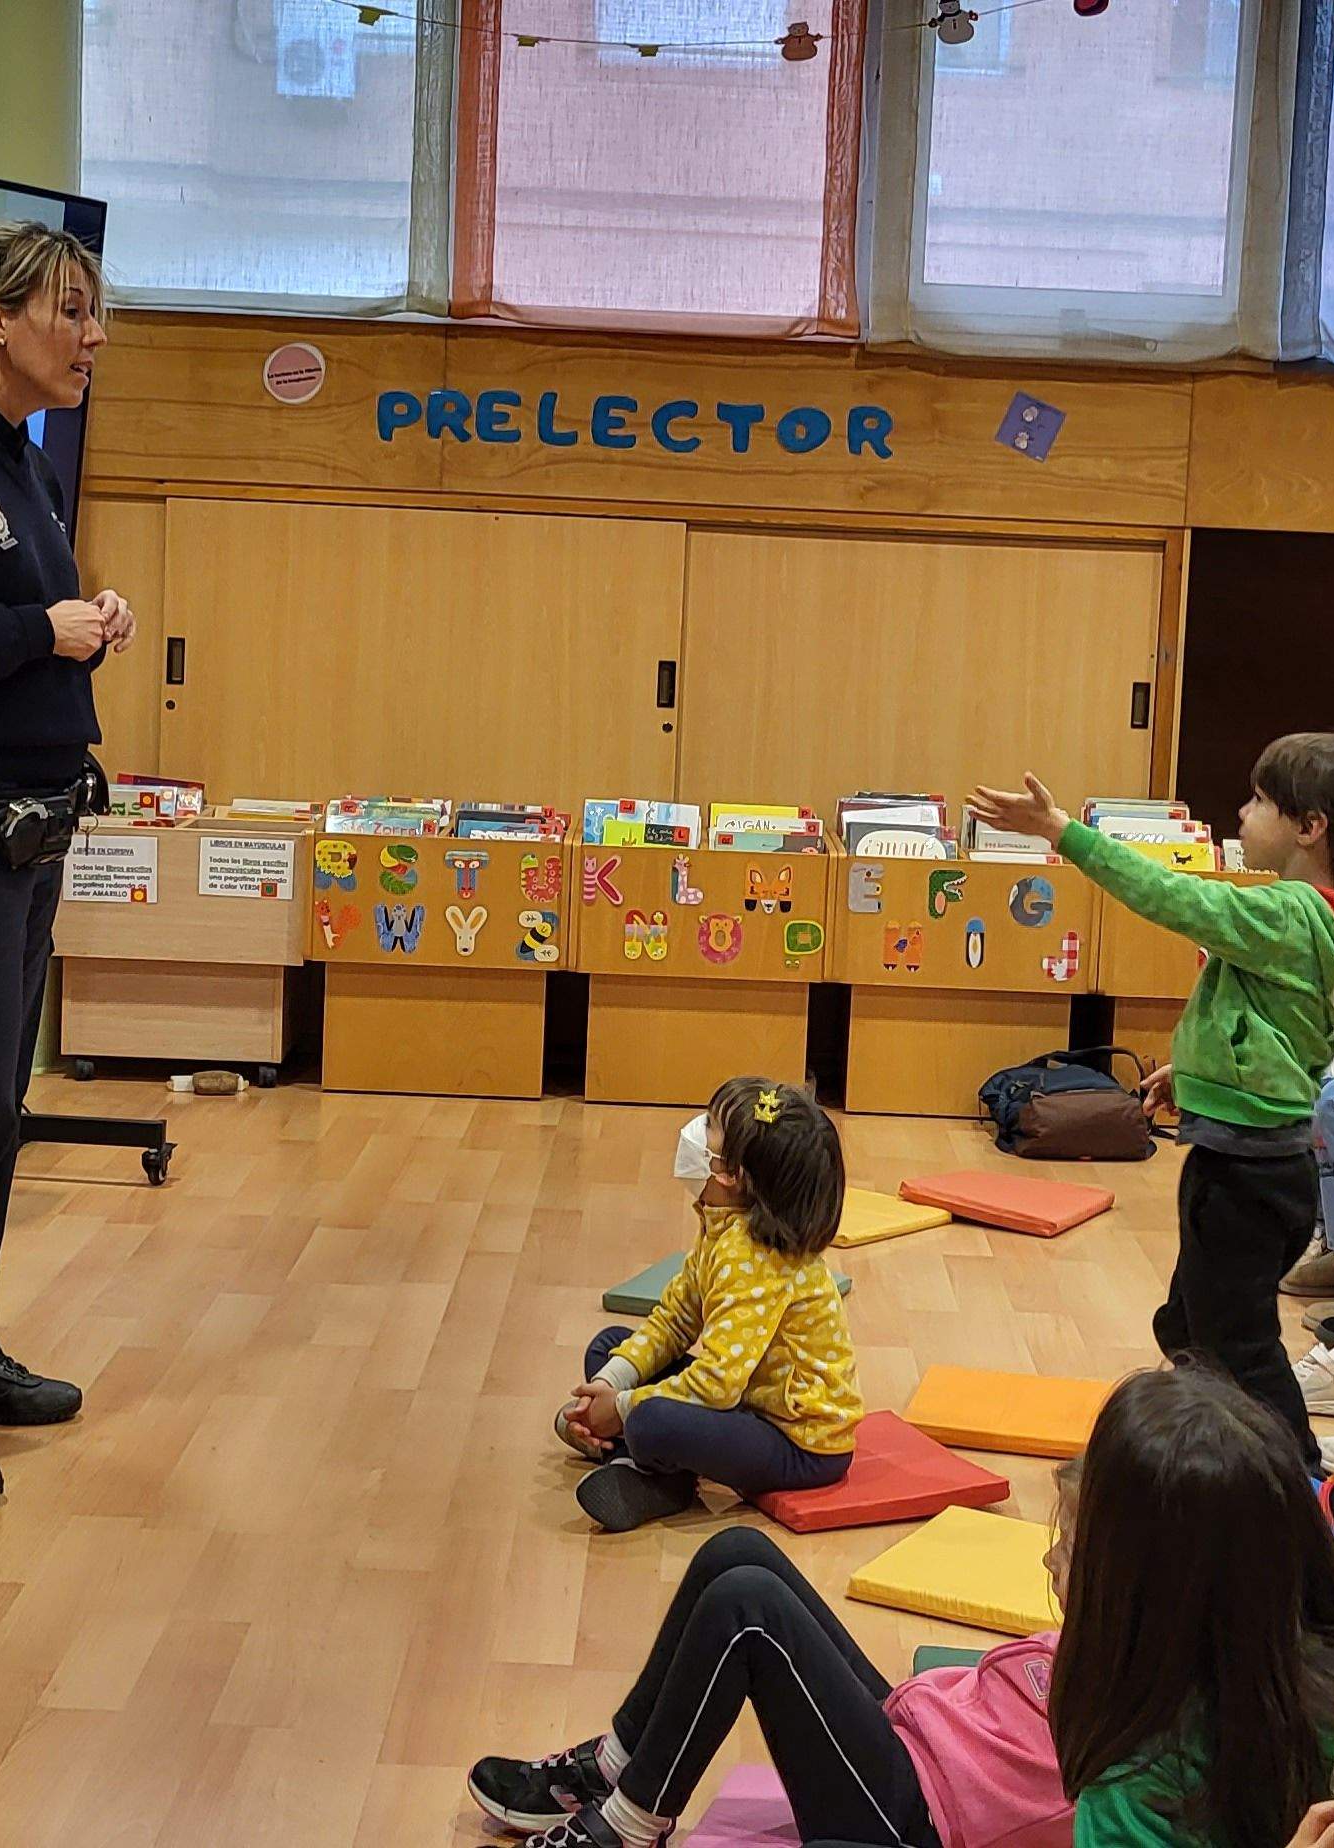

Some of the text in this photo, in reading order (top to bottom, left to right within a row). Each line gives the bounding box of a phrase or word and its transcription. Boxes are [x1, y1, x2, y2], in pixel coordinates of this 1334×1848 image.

[377, 388, 894, 459] PRELECTOR
[73, 863, 94, 871] Todos
[106, 865, 124, 873] libros
[209, 856, 229, 864] Todos
[242, 858, 261, 866] libros
[220, 882, 238, 890] color
[224, 875, 256, 883] pegatina
[262, 867, 285, 875] tienen
[443, 849, 490, 901] T
[519, 852, 562, 903] U
[581, 854, 624, 907] K
[670, 853, 705, 906] L
[848, 862, 885, 914] E
[1009, 874, 1055, 929] G
[373, 902, 426, 955] W
[444, 904, 489, 958] Y
[1041, 930, 1081, 982] J
